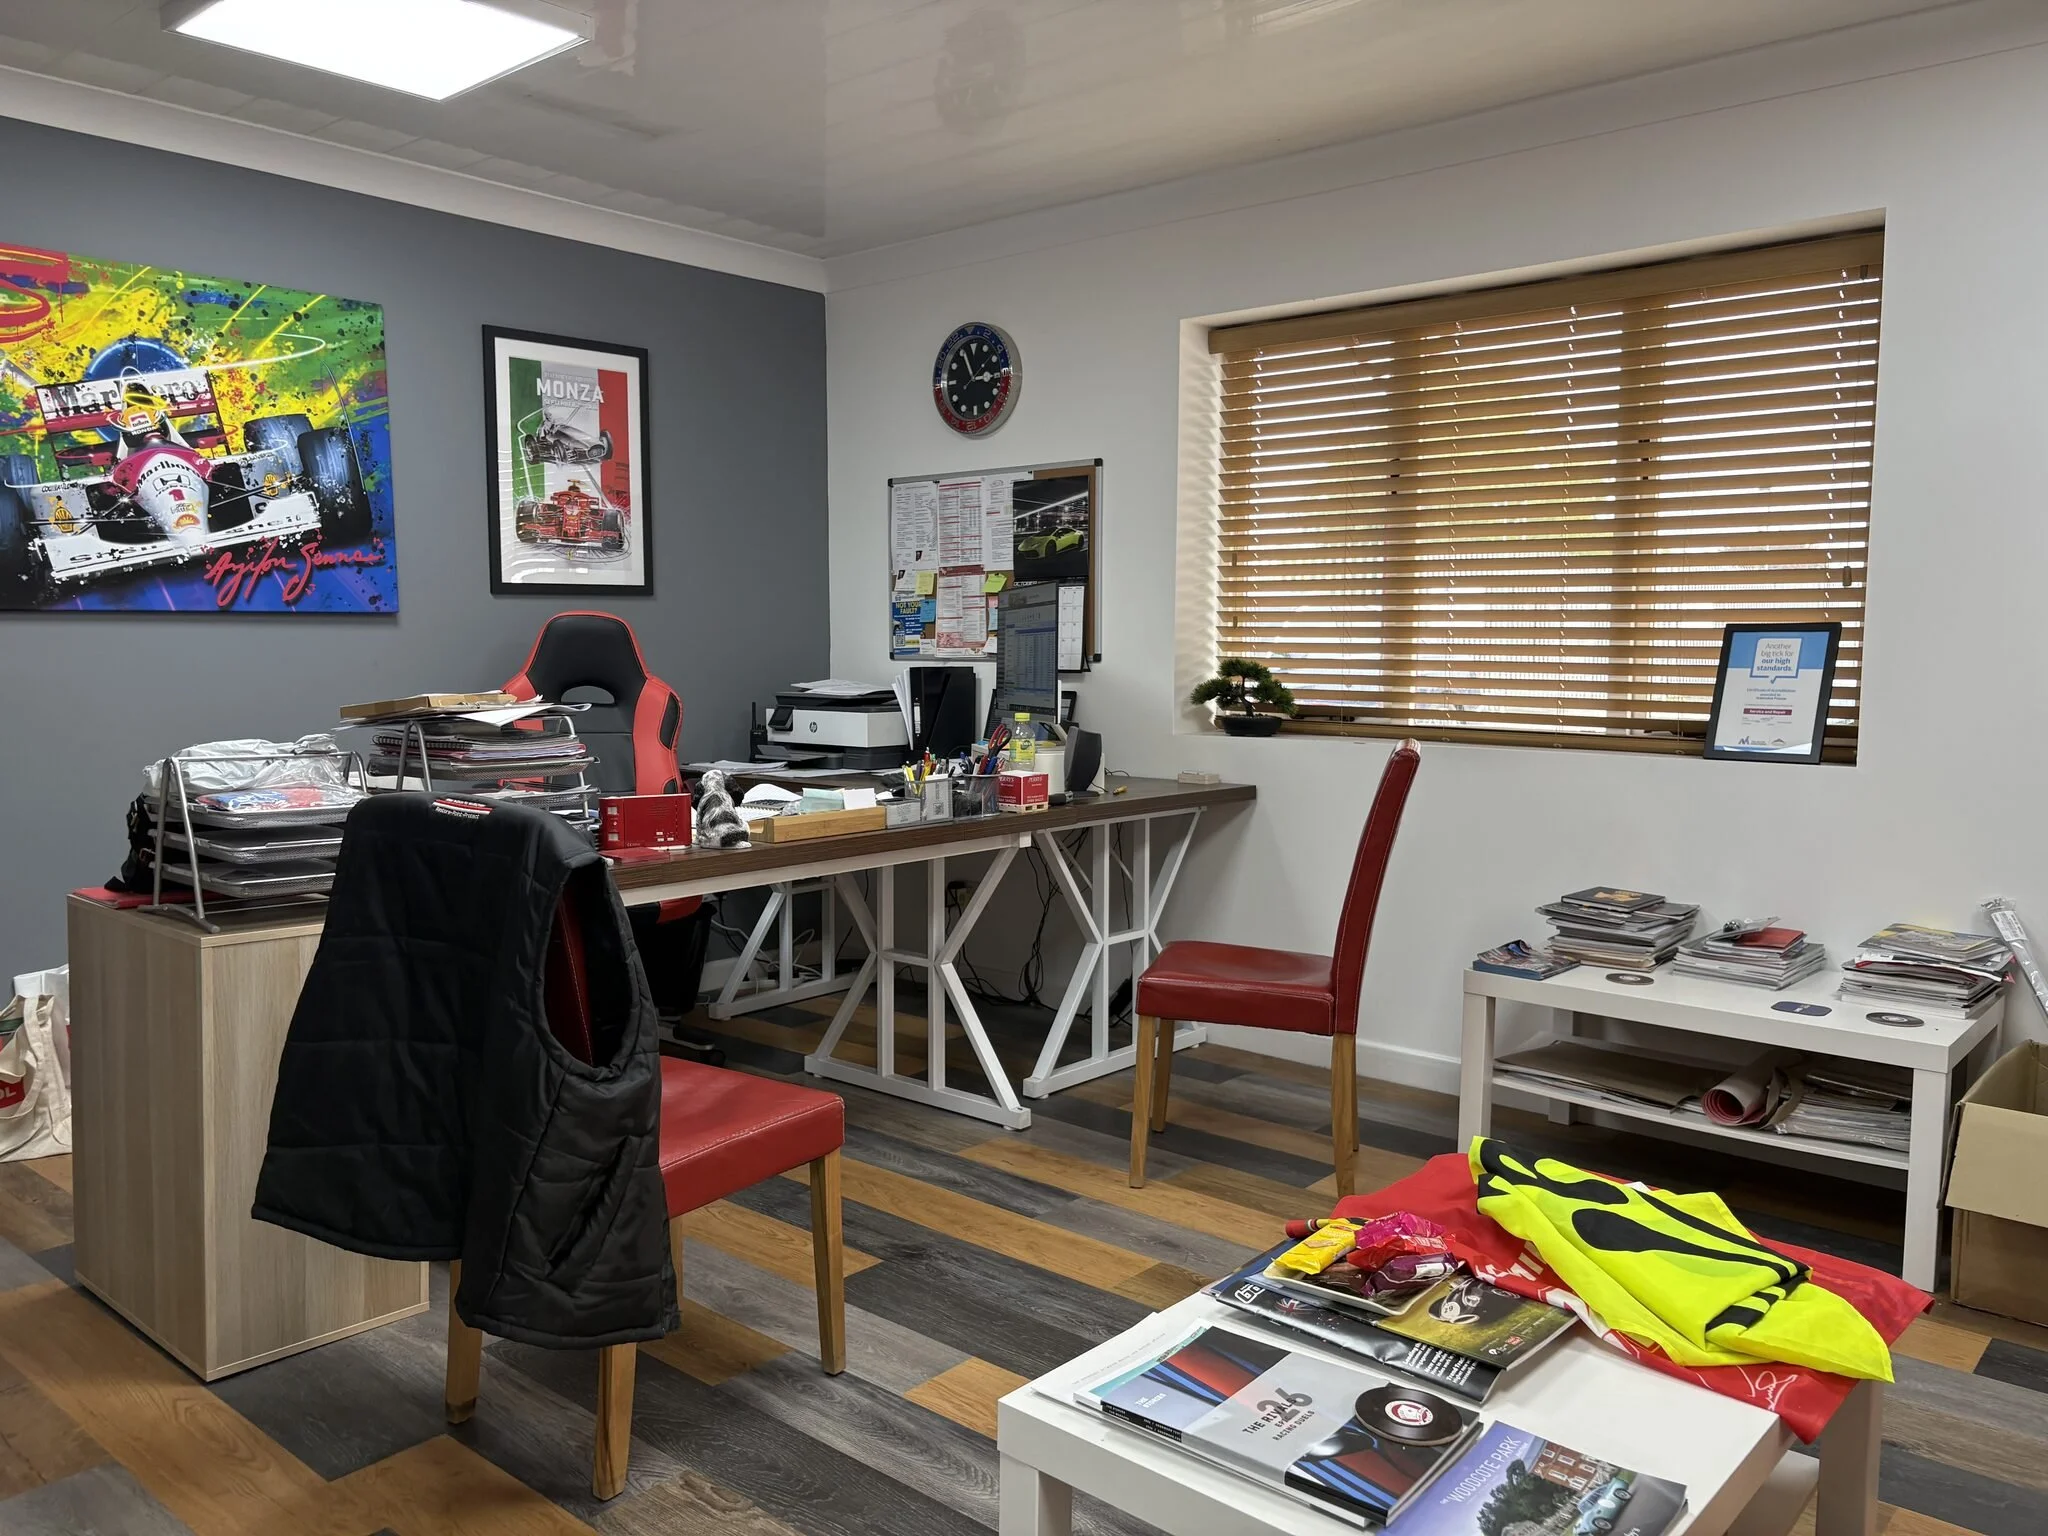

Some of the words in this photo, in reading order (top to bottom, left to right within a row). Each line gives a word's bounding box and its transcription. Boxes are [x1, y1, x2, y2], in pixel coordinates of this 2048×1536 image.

[536, 377, 604, 404] MONZA
[1765, 642, 1792, 650] Another
[1242, 1421, 1266, 1434] THE
[1261, 1397, 1297, 1423] RIVALS
[1257, 1387, 1313, 1423] 26
[1272, 1424, 1297, 1441] RACING
[1295, 1410, 1315, 1426] DUELS
[1446, 1460, 1501, 1502] WOODCOTE
[1491, 1435, 1521, 1462] PARK
